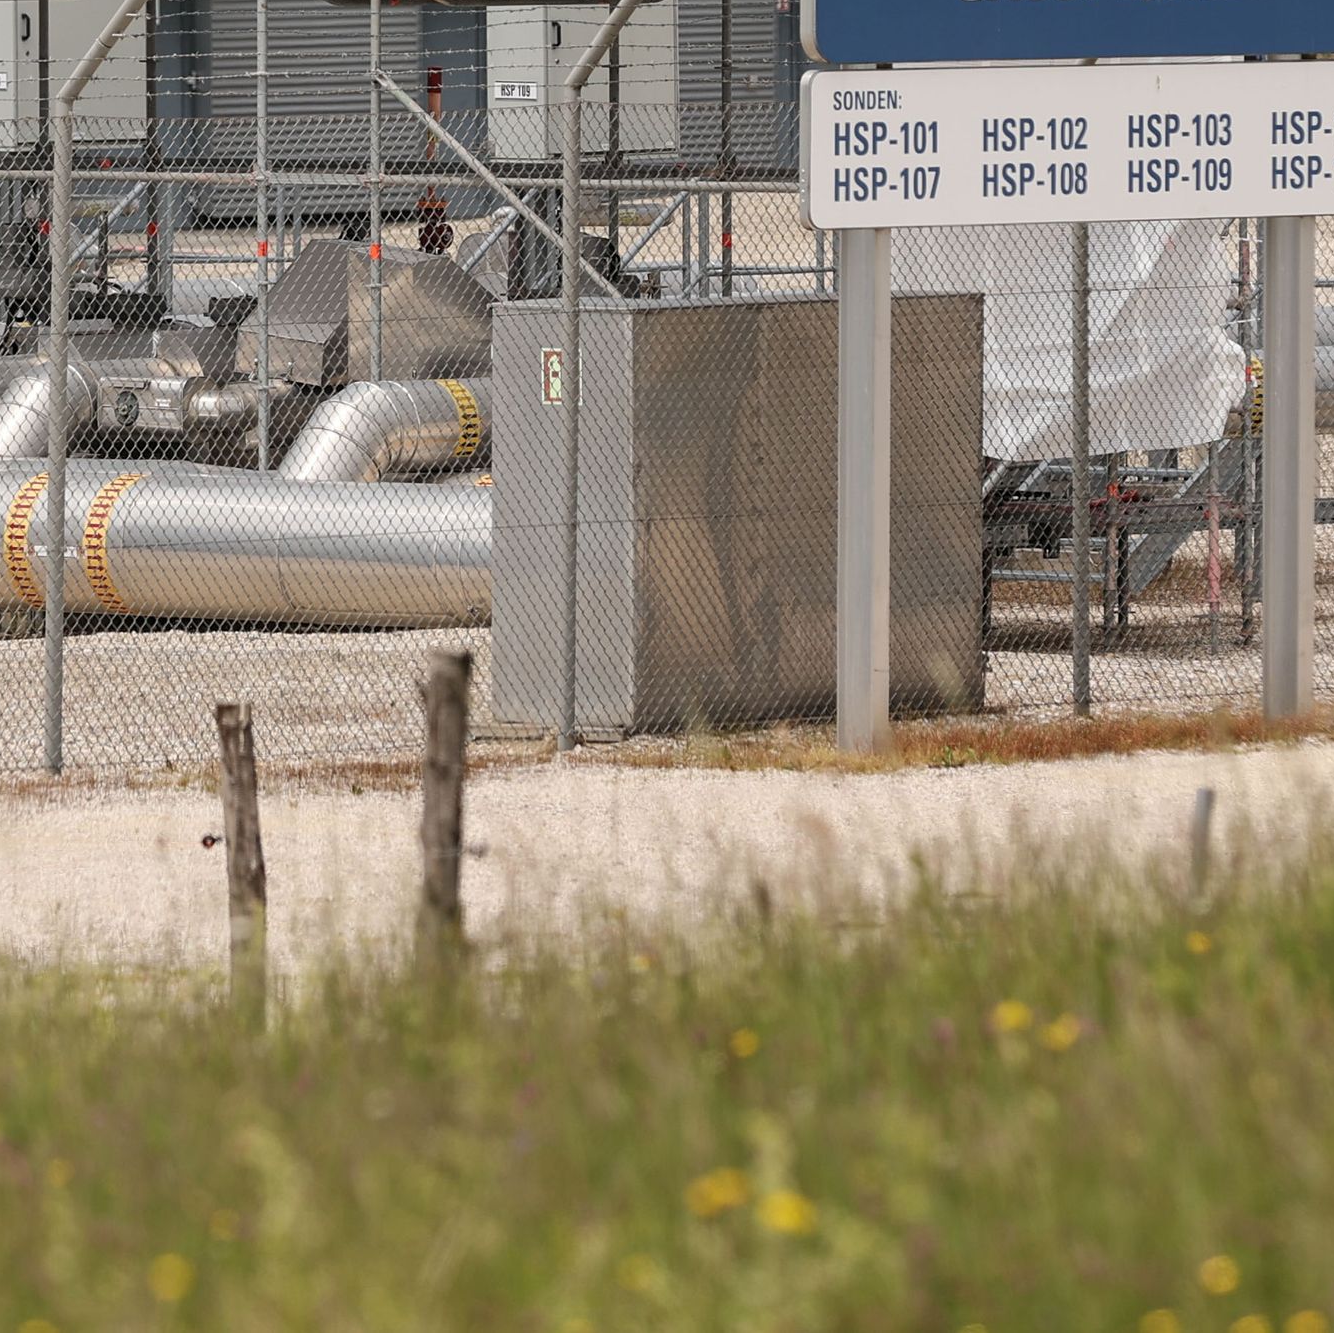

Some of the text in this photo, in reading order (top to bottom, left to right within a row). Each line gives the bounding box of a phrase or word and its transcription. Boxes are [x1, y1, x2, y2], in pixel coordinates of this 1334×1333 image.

[500, 84, 531, 97] HSP 109
[832, 90, 902, 111] SONDEN:
[834, 120, 939, 156] HSP-101
[982, 117, 1088, 152] HSP-102
[1128, 113, 1232, 148] HSP-103
[834, 166, 941, 202] HSP-107
[982, 162, 1088, 197] HSP-108
[1128, 158, 1232, 192] HSP-109
